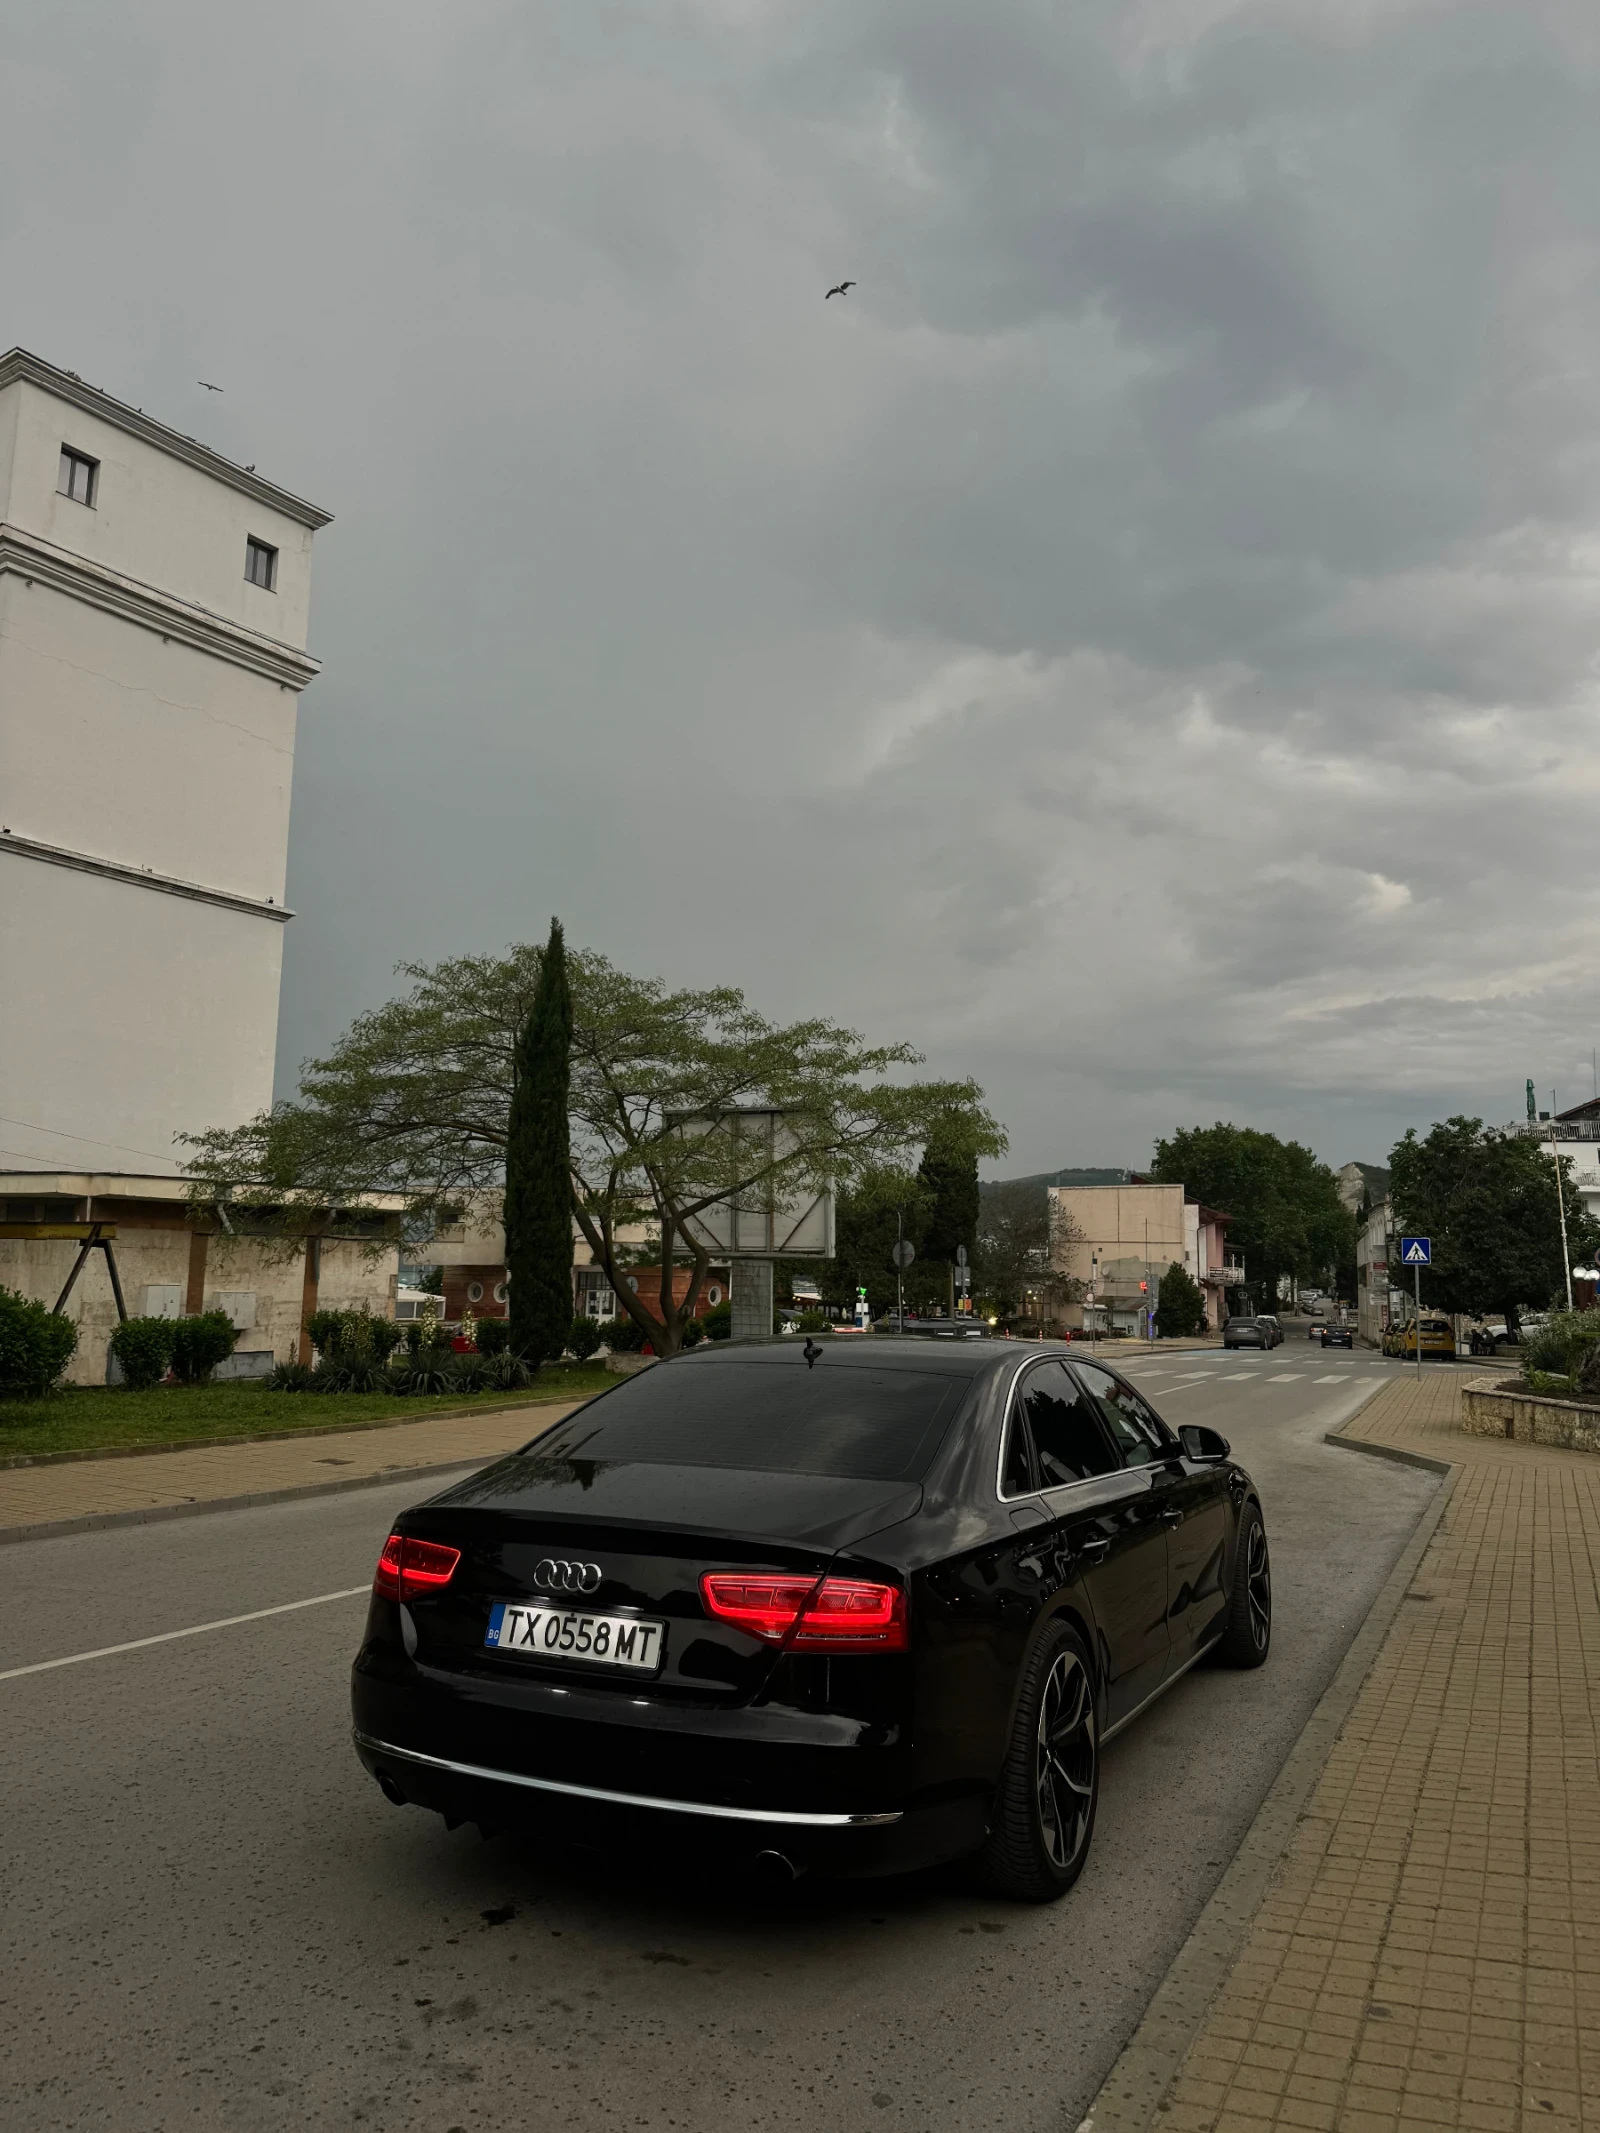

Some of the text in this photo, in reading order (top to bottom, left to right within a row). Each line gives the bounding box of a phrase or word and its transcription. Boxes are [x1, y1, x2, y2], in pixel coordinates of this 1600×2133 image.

[488, 1629, 500, 1640] BG
[508, 1609, 657, 1661] TX 0558 MT
